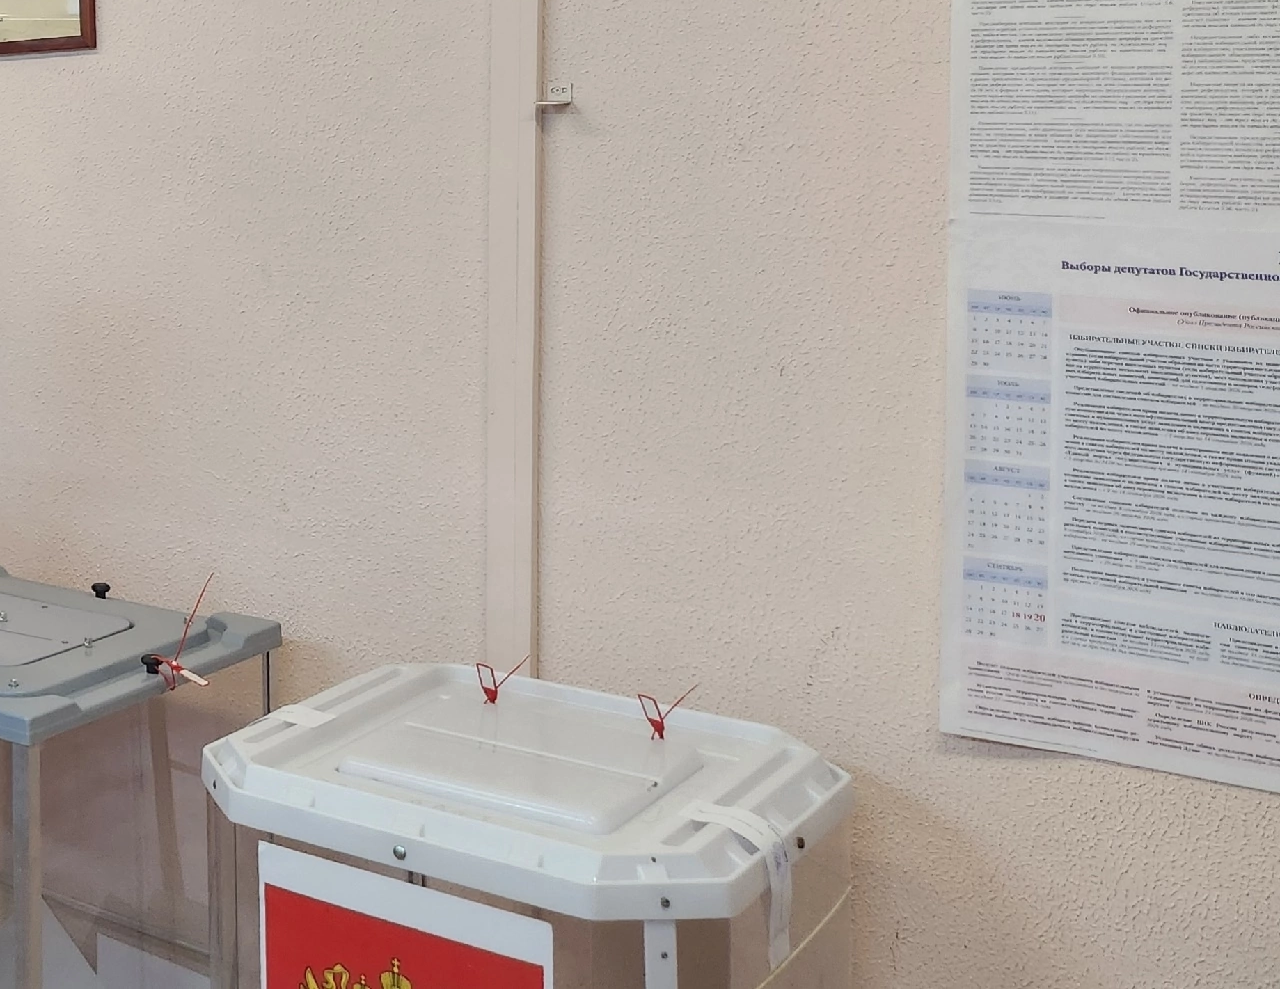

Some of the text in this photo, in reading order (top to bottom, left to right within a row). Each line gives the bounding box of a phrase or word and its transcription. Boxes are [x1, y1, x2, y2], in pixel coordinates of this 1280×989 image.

[1061, 260, 1280, 283] Выборы депутатов Государственно
[1069, 334, 1139, 346] ИЗБИРАТЕЛЬНЫЕ
[1033, 613, 1046, 622] 20
